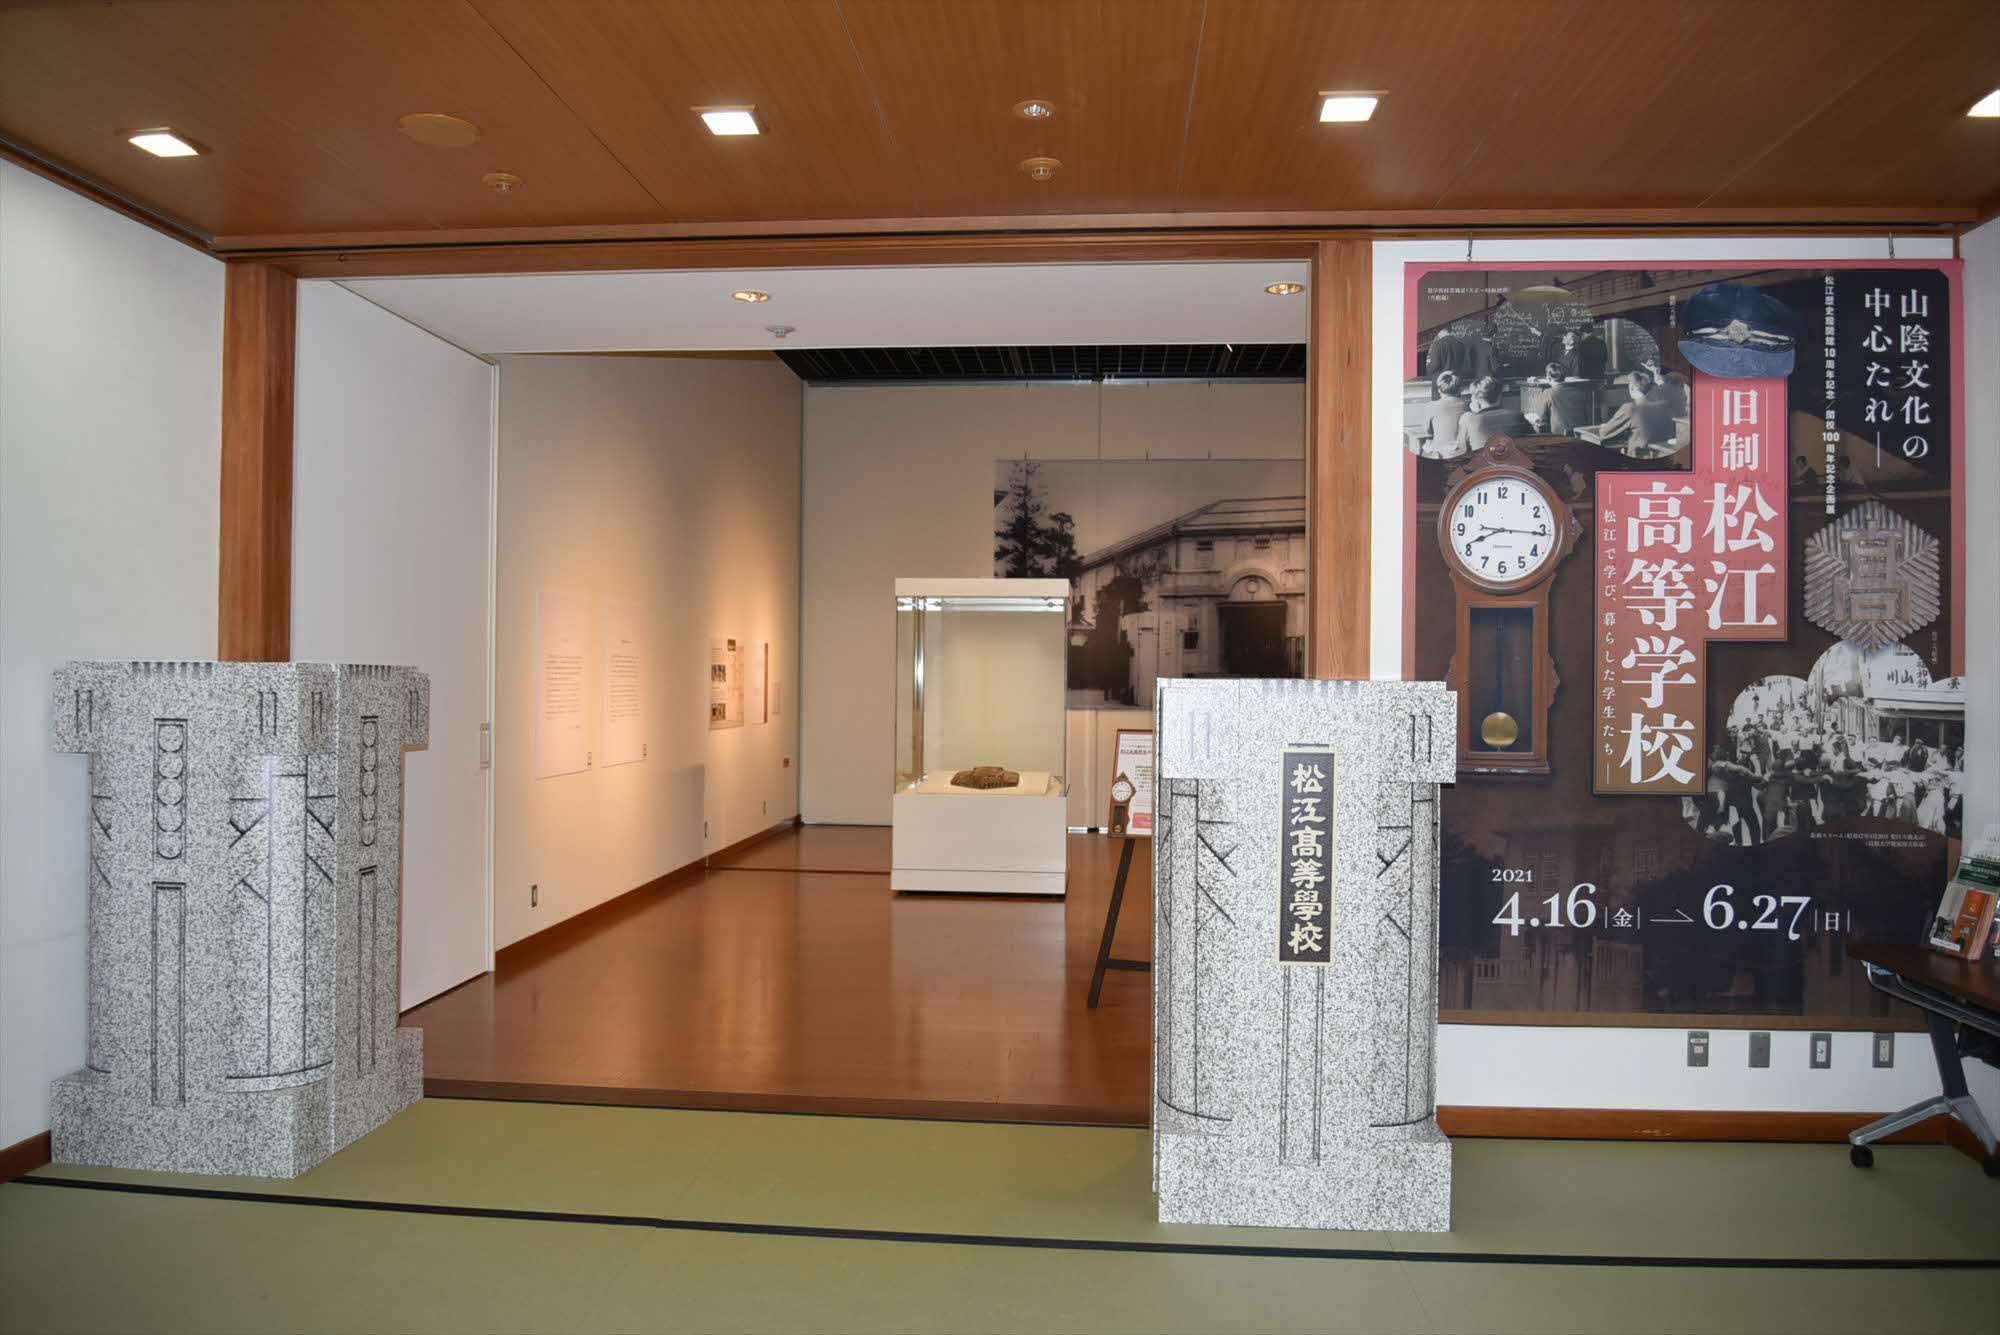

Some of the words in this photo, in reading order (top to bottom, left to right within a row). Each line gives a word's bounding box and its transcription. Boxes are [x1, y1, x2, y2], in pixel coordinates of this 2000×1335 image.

[1900, 288, 1931, 458] 山陰文化の
[1720, 389, 1760, 472] 旧制
[1477, 492, 1488, 505] 11
[1497, 486, 1508, 499] 12
[1464, 505, 1474, 518] 10
[1532, 505, 1541, 518] 2
[1457, 523, 1465, 536] 9
[1539, 524, 1546, 536] 3
[1465, 544, 1472, 557] 8
[1530, 544, 1538, 557] 4
[1702, 483, 1779, 631] 松江
[1481, 556, 1489, 569] 7
[1498, 561, 1507, 574] 6
[1518, 556, 1526, 569] 5
[1619, 481, 1696, 785] 高等学校
[1491, 869, 1533, 882] 2021
[1492, 883, 1596, 936] 4.16
[1611, 907, 1633, 928] 金
[1703, 885, 1811, 941] 6.27
[1824, 912, 1840, 931] 日
